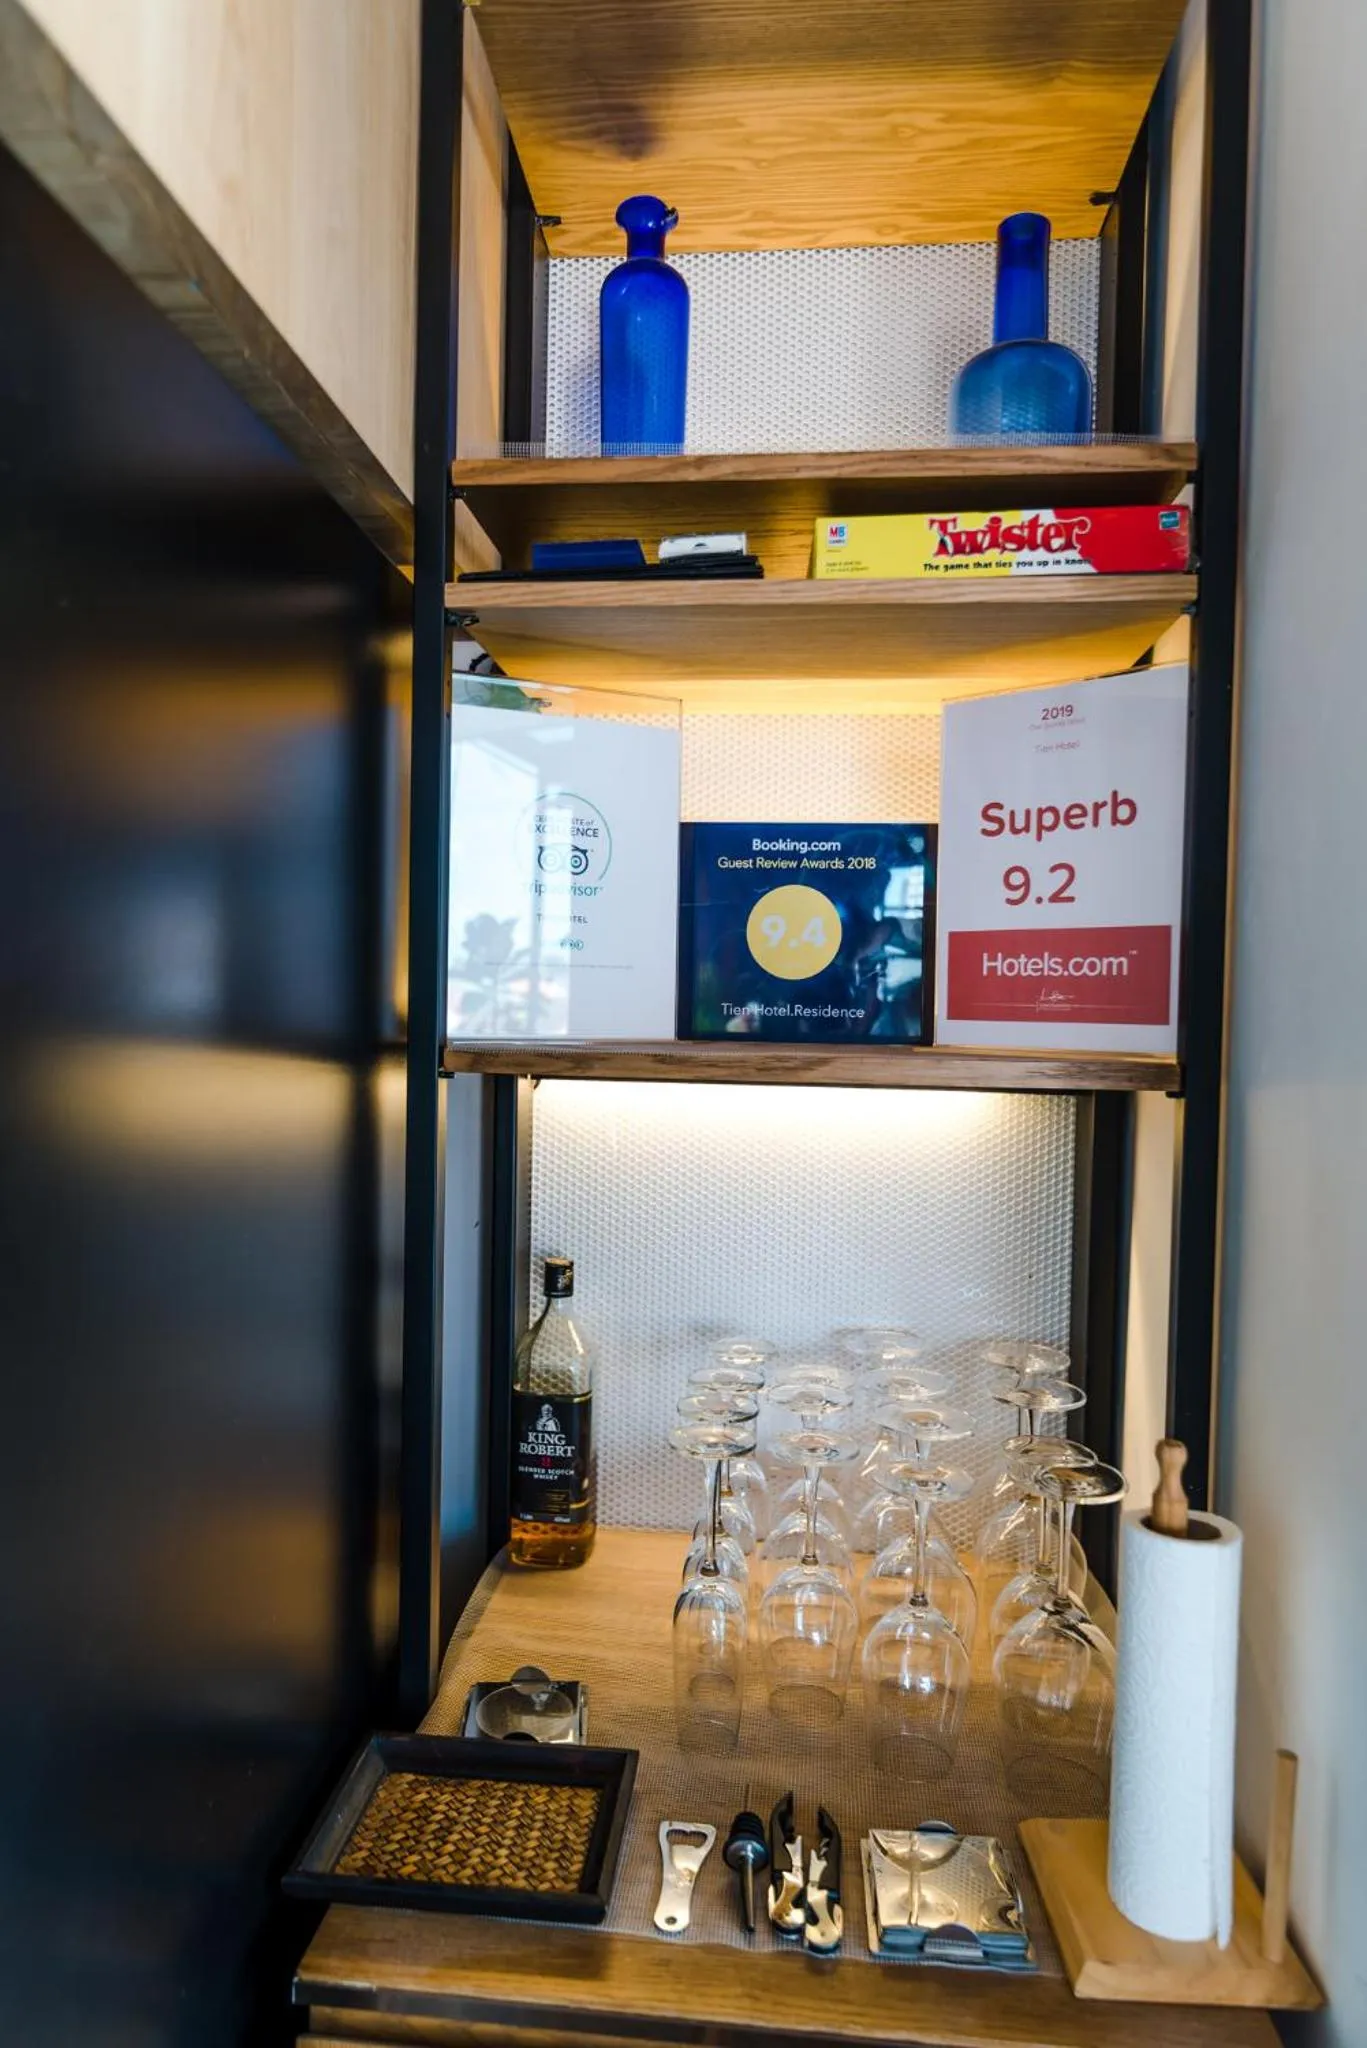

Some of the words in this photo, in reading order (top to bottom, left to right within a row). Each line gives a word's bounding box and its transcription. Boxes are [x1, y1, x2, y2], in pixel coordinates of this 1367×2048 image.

[829, 526, 846, 537] MB
[928, 513, 1091, 557] Twister
[923, 563, 940, 572] The
[943, 562, 970, 572] game
[973, 561, 992, 569] that
[995, 559, 1013, 568] ties
[1016, 559, 1034, 569] you
[1036, 559, 1049, 569] up
[1052, 558, 1062, 566] in
[1041, 704, 1074, 720] 2019
[980, 790, 1138, 842] Superb
[752, 838, 841, 854] Booking.com
[717, 856, 753, 869] Guest
[756, 857, 798, 869] Review
[800, 857, 845, 869] Awards
[847, 857, 877, 869] 2018
[1002, 862, 1076, 906] 9.2
[760, 914, 827, 948] 9.4
[982, 952, 1128, 977] Hotels.com
[721, 1002, 749, 1016] Tien
[755, 1004, 865, 1018] Hotel.Residence
[528, 1431, 566, 1445] KING
[519, 1442, 576, 1457] ROBERT
